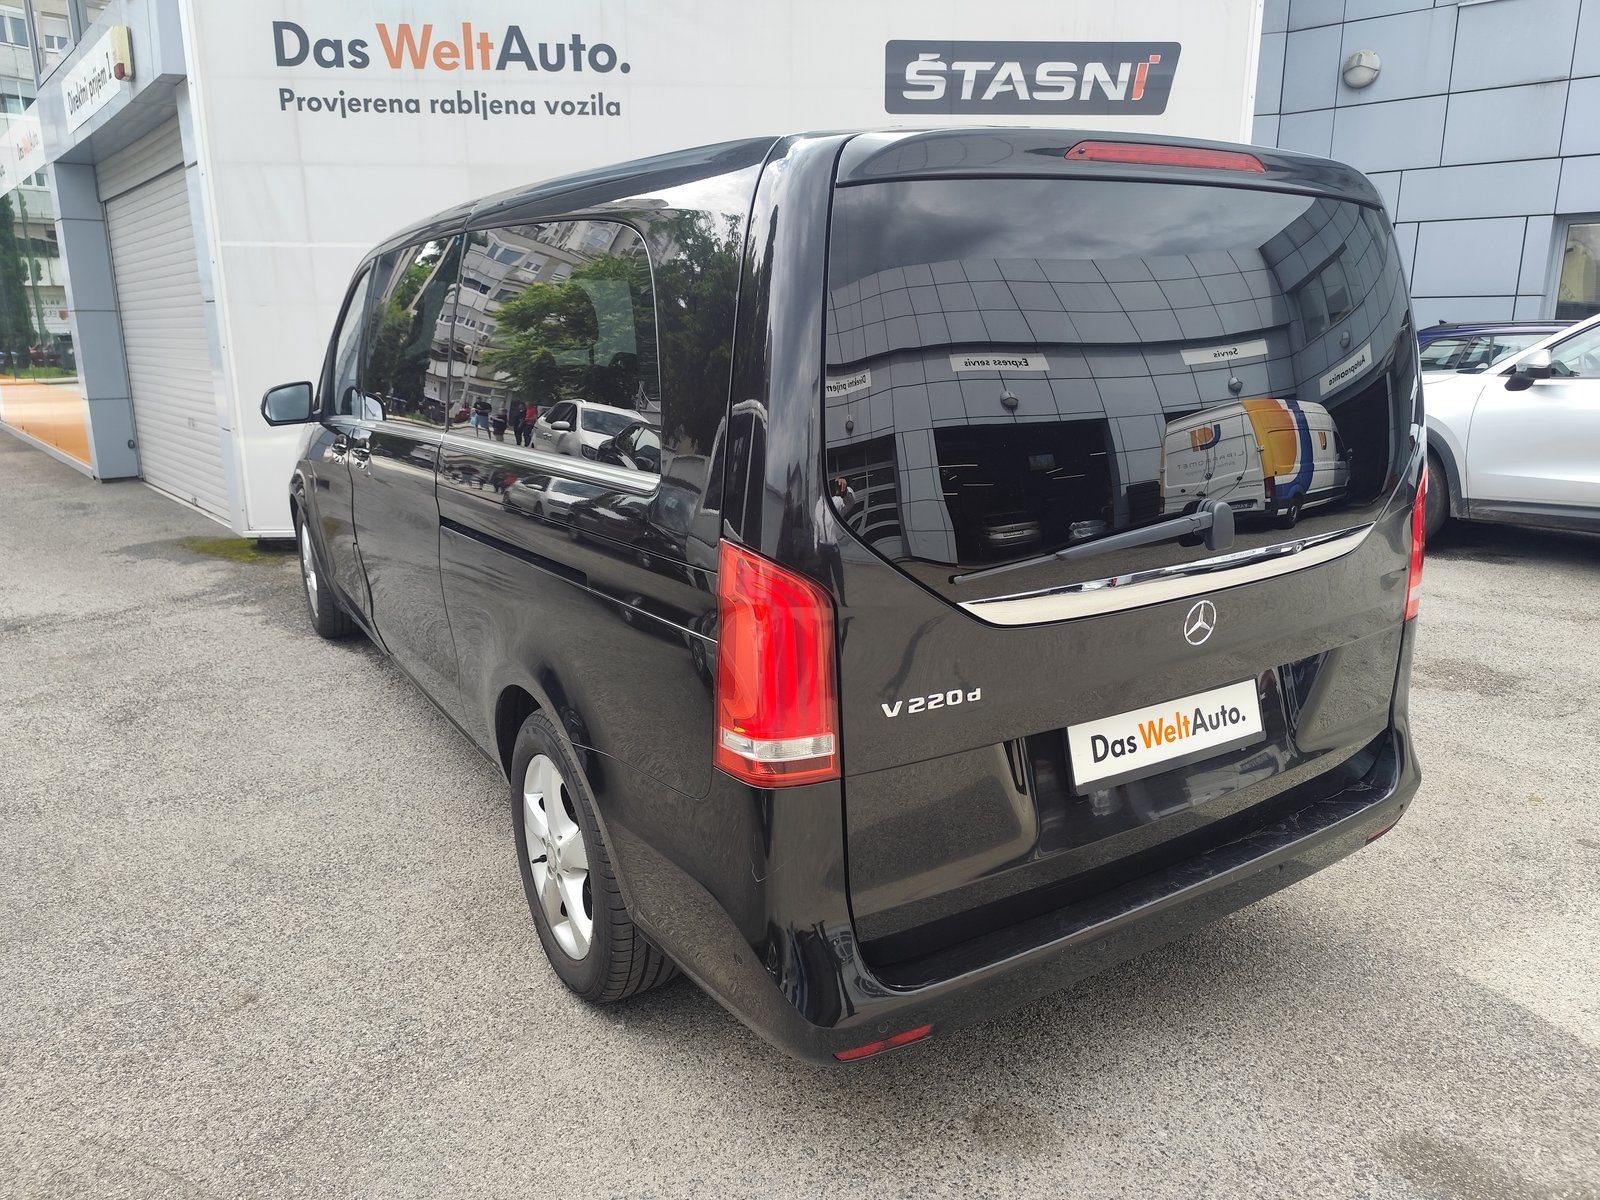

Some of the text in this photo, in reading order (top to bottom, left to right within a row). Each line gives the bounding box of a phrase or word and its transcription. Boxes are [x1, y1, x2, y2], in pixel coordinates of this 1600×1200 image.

[272, 20, 631, 74] Das WeltAuto.
[67, 52, 112, 115] Direktni prijem 1
[279, 87, 621, 120] Provjerena rabljena vozila
[1090, 704, 1247, 763] Das WeltAuto.
